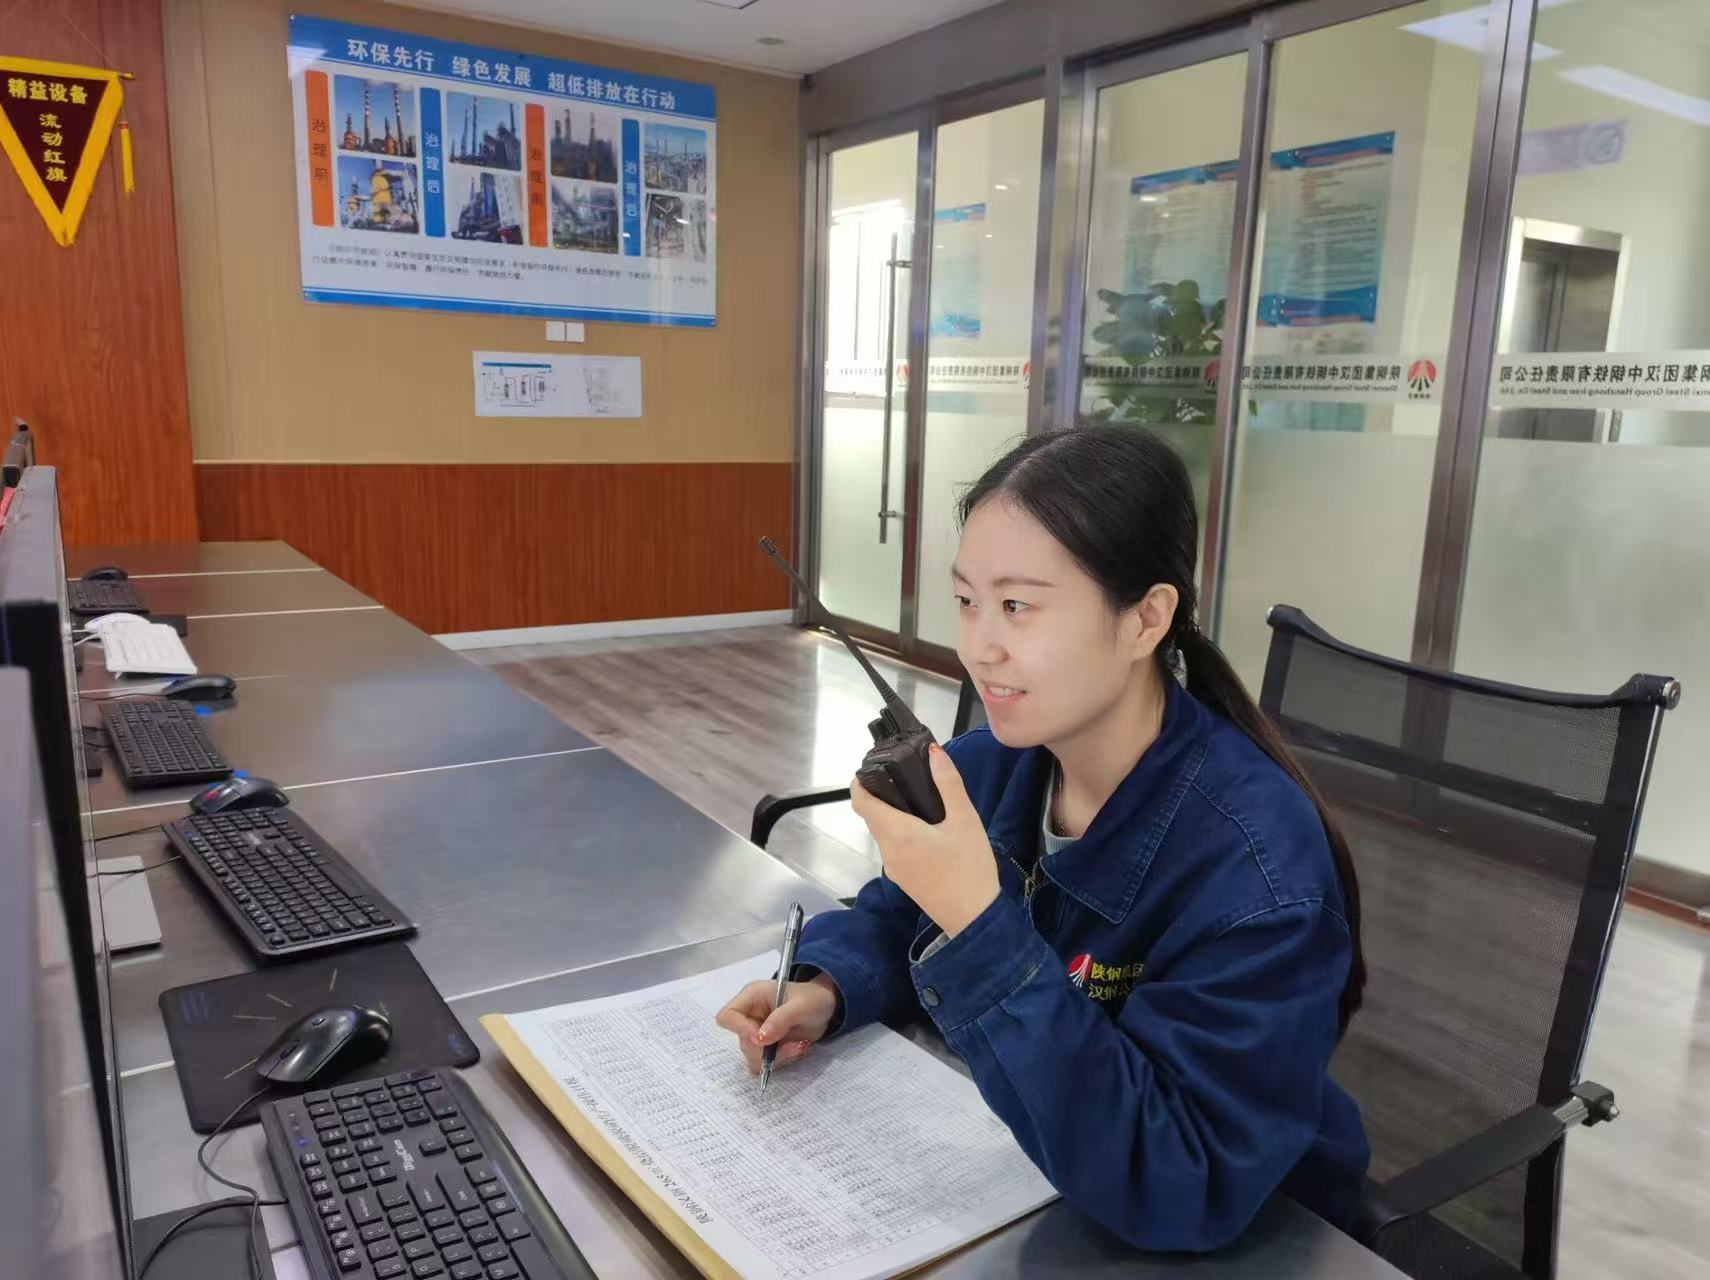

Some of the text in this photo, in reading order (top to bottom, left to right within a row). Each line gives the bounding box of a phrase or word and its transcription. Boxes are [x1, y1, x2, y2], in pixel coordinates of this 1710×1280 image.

[8, 77, 88, 104] 精益设备
[347, 38, 676, 110] 环保先行 绿色发展 超低排放在行动
[39, 113, 68, 182] 流动红旗
[424, 131, 441, 194] 治理后
